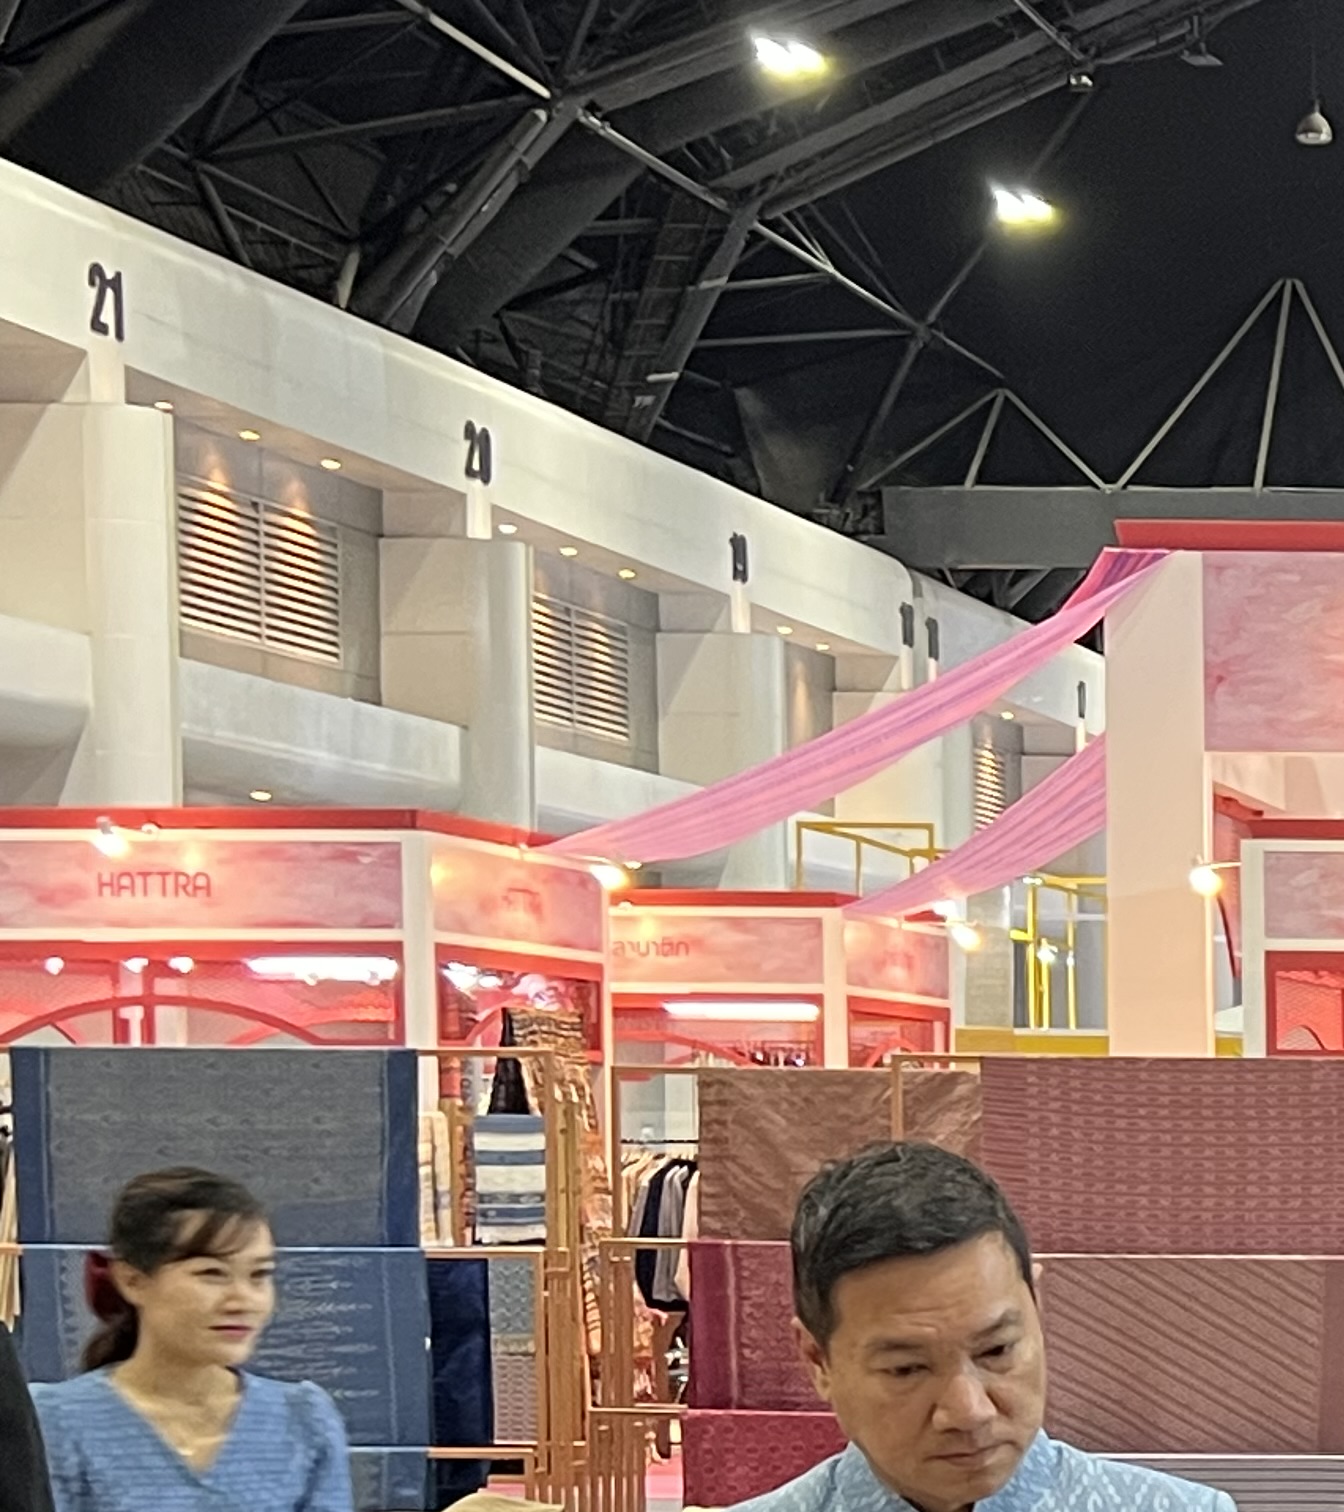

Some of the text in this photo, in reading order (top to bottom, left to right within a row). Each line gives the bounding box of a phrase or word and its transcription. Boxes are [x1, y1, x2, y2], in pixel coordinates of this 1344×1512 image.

[88, 261, 124, 342] 21
[463, 419, 491, 485] 20
[97, 871, 211, 898] HATTRA
